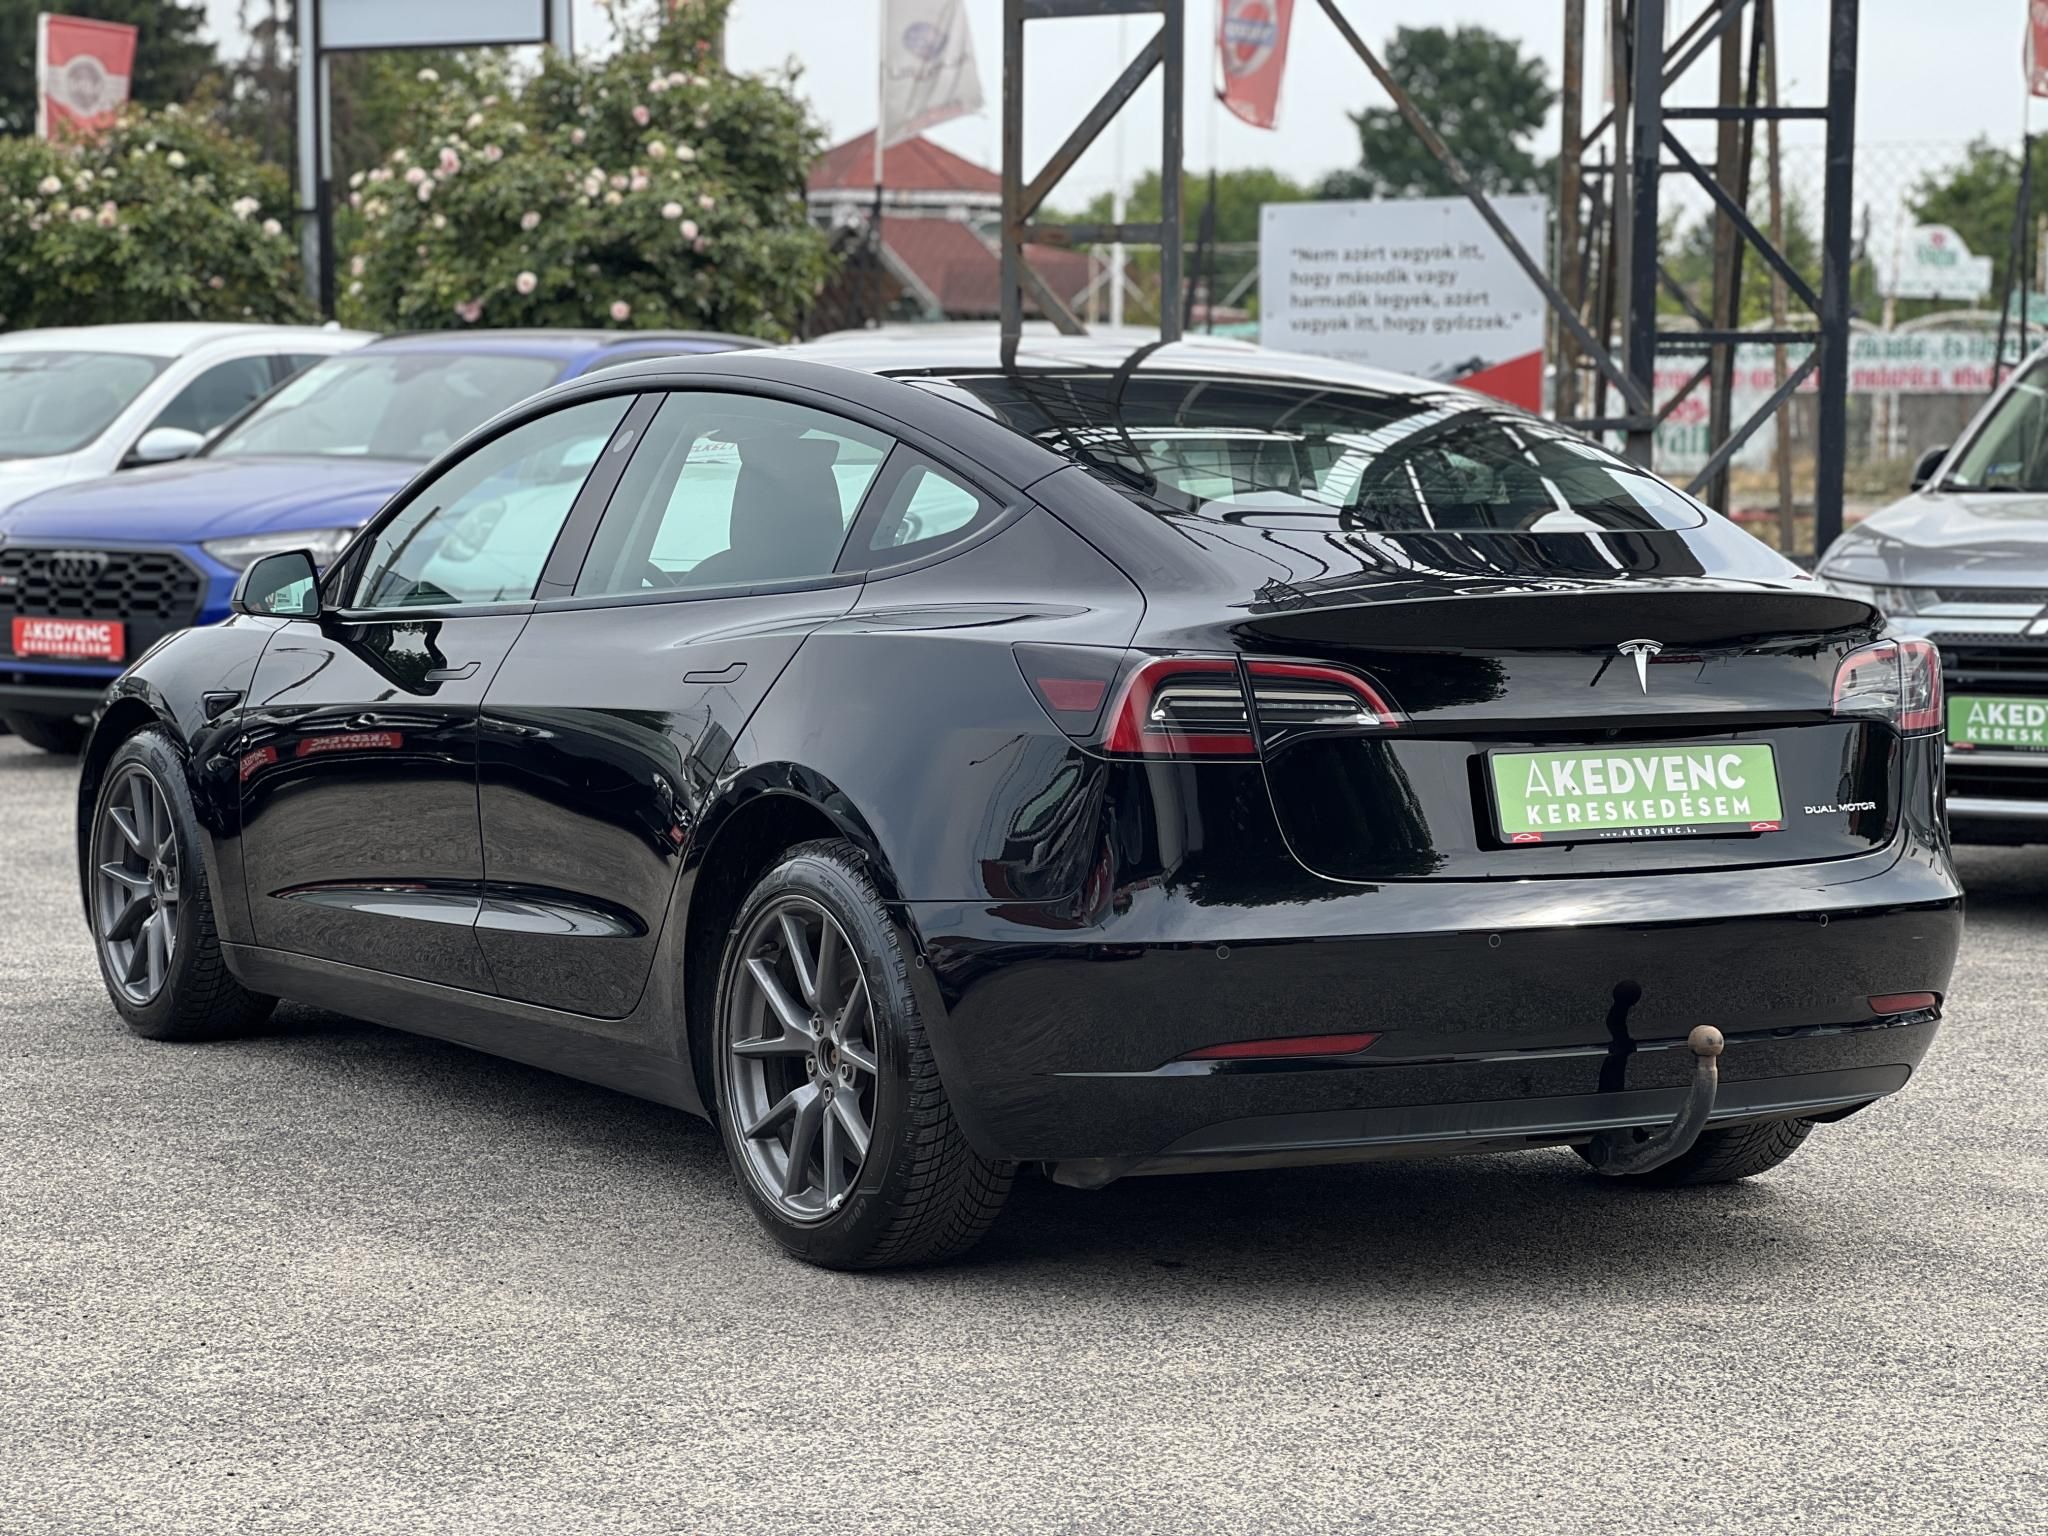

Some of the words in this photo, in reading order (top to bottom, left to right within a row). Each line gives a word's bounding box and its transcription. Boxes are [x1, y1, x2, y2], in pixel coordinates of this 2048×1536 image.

[1343, 246, 1385, 261] azért
[1391, 244, 1453, 264] vagyok
[1459, 243, 1485, 261] itt,
[1290, 267, 1330, 287] hogy
[1337, 267, 1408, 284] második
[1415, 268, 1457, 287] vagy
[1290, 291, 1369, 308] harmadik
[1374, 291, 1439, 311] legyek,
[1444, 290, 1489, 308] azért
[1290, 314, 1348, 333] vagyok
[1384, 313, 1427, 333] hogy
[23, 621, 111, 643] AKEDVENC
[1967, 701, 2048, 726] AKED
[1525, 753, 1746, 798] AKEDVENC
[1526, 792, 1750, 825] KERESKEDÉSEM
[1804, 804, 1837, 815] DUAL
[1838, 801, 1877, 812] MOTOR
